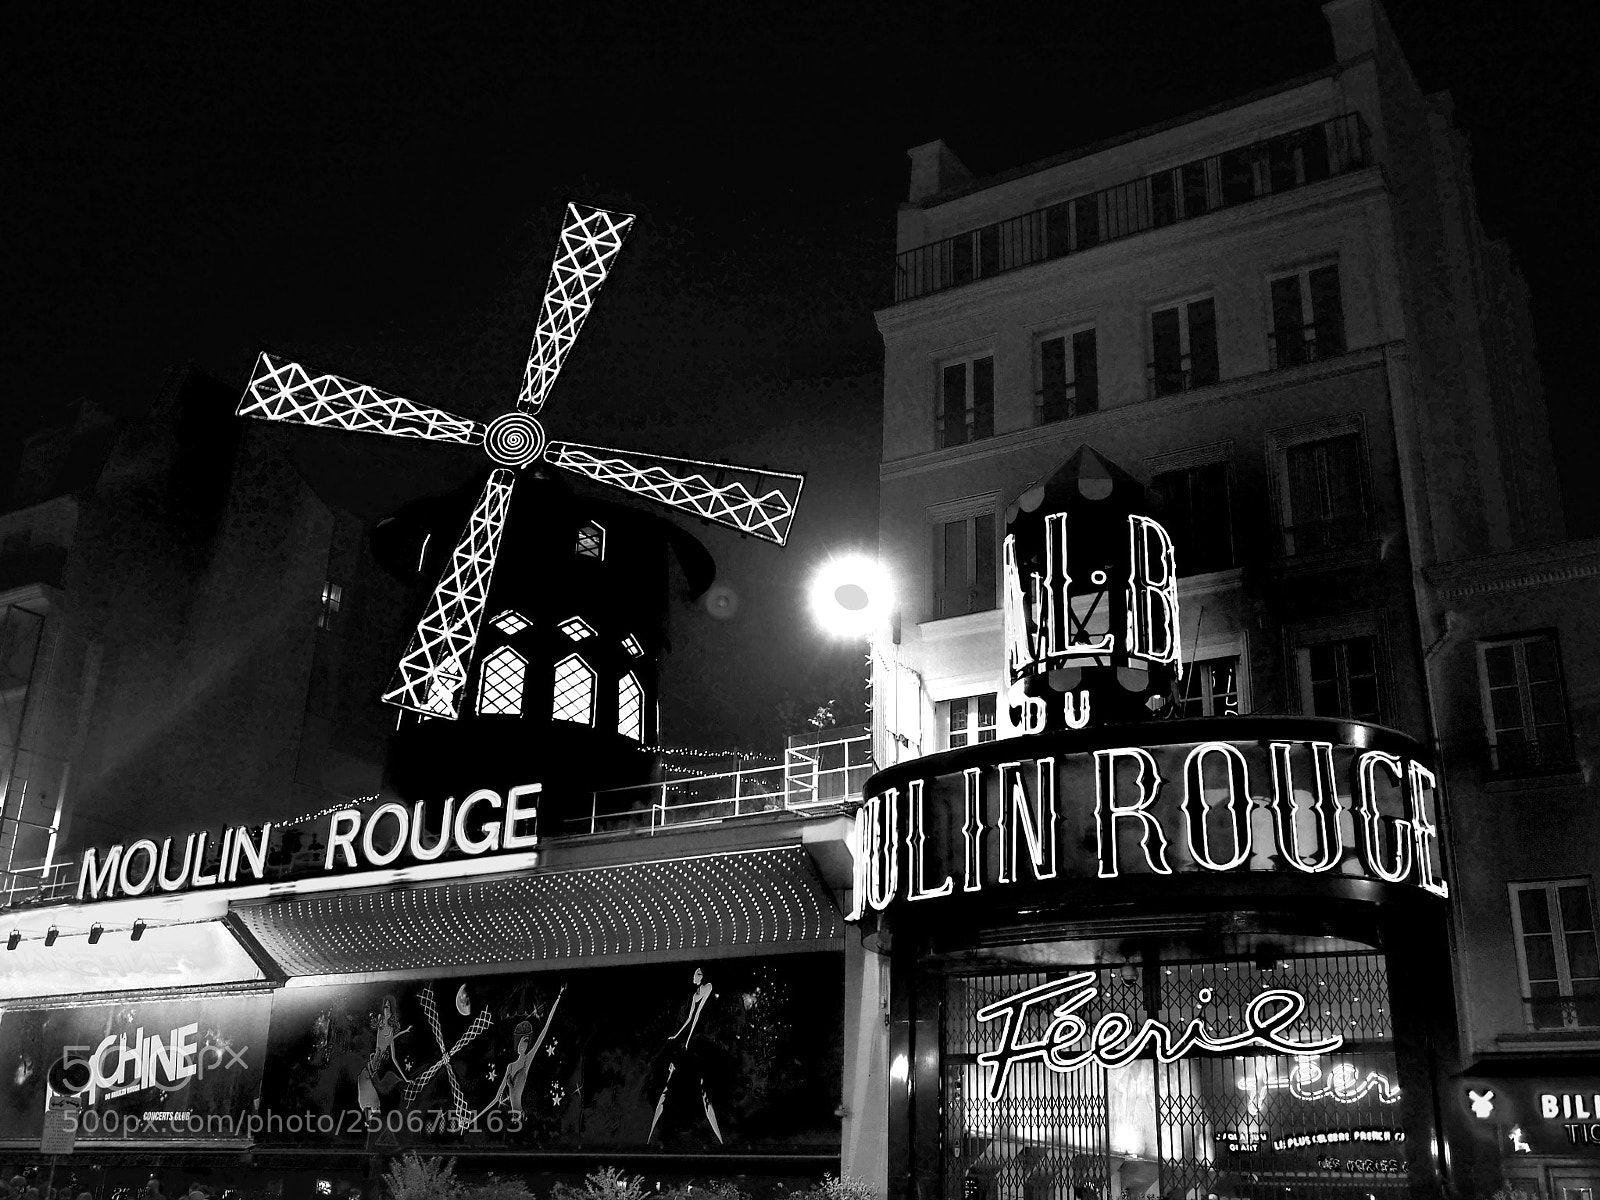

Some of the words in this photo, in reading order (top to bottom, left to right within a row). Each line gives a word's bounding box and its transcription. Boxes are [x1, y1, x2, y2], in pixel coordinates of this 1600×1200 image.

[1021, 690, 1090, 735] DU
[76, 821, 272, 900] MOULIN
[324, 782, 542, 870] ROUGE
[1092, 741, 1449, 898] ROUGE
[977, 970, 1343, 1102] Féerie
[143, 1111, 173, 1121] CONCERTS
[174, 1111, 191, 1121] CLUB
[1287, 1135, 1311, 1148] PLUS
